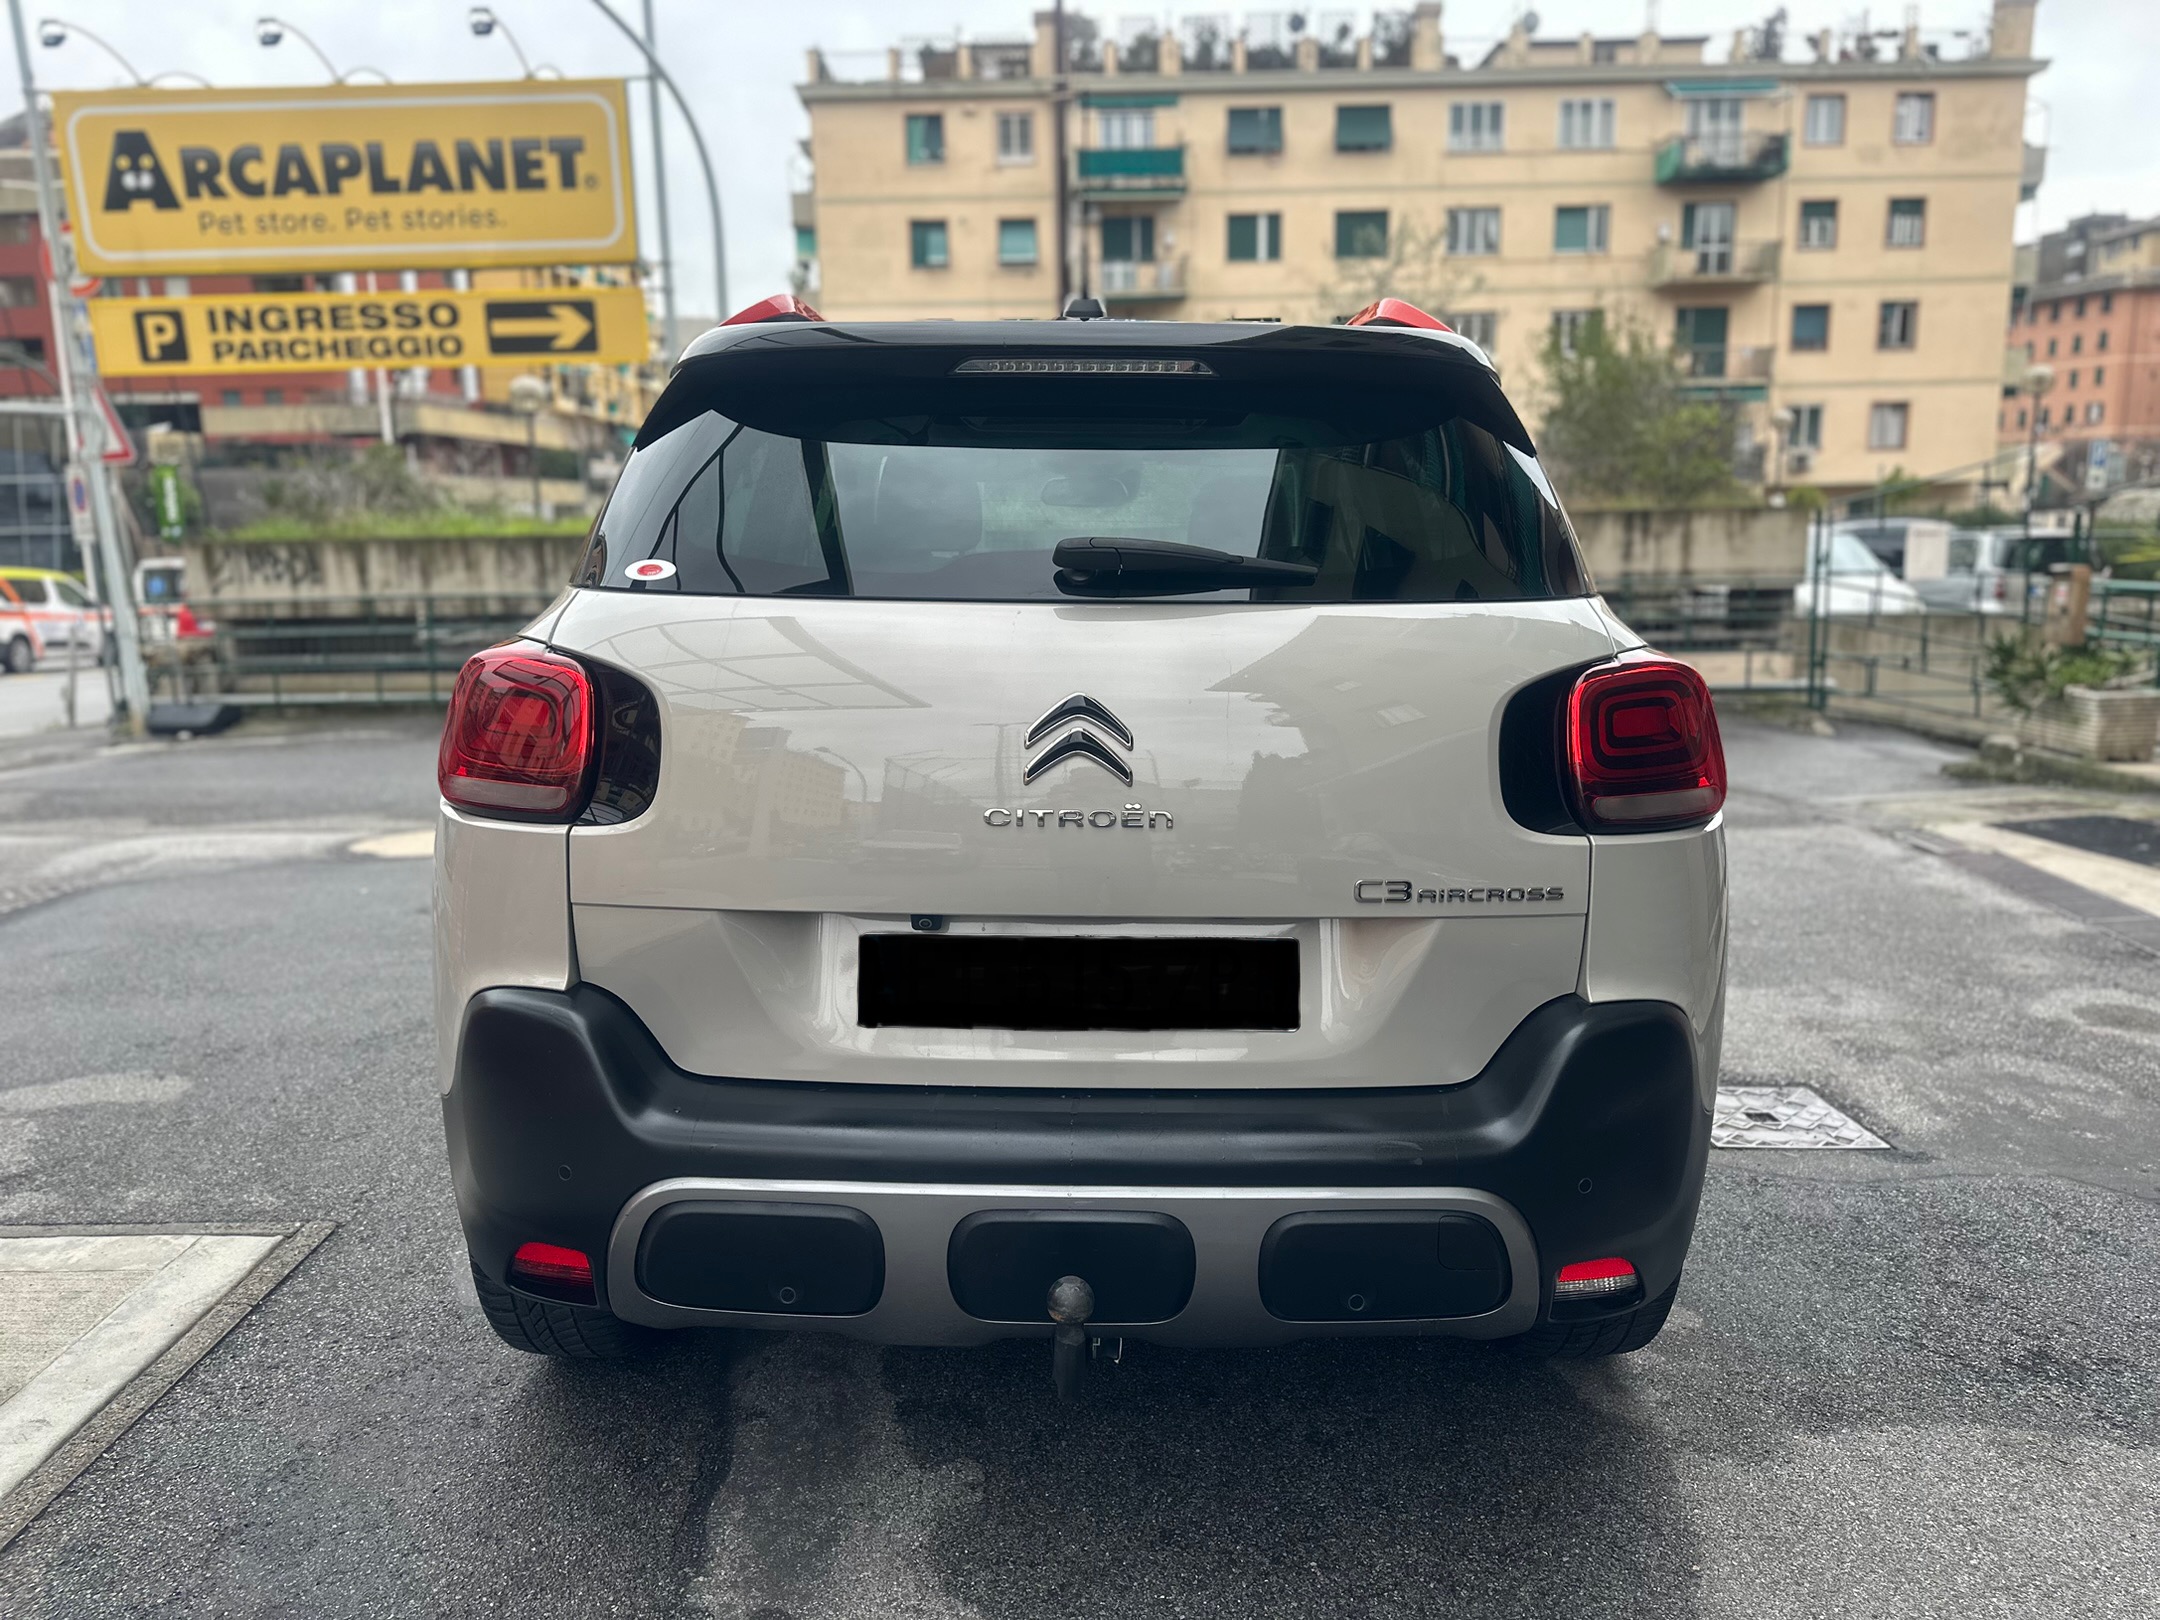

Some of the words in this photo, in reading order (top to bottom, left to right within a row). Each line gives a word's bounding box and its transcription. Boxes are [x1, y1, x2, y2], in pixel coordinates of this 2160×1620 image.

[103, 130, 587, 212] ARCAPLANET
[198, 209, 246, 236] Pet
[253, 211, 337, 235] store.
[345, 206, 392, 232] Pet
[403, 204, 507, 231] stories.
[207, 302, 459, 333] INGRESSO
[142, 312, 178, 360] P
[212, 335, 463, 362] PARCHEGGIO
[1353, 879, 1413, 904] C3
[1417, 887, 1565, 903] AIRCROSS
